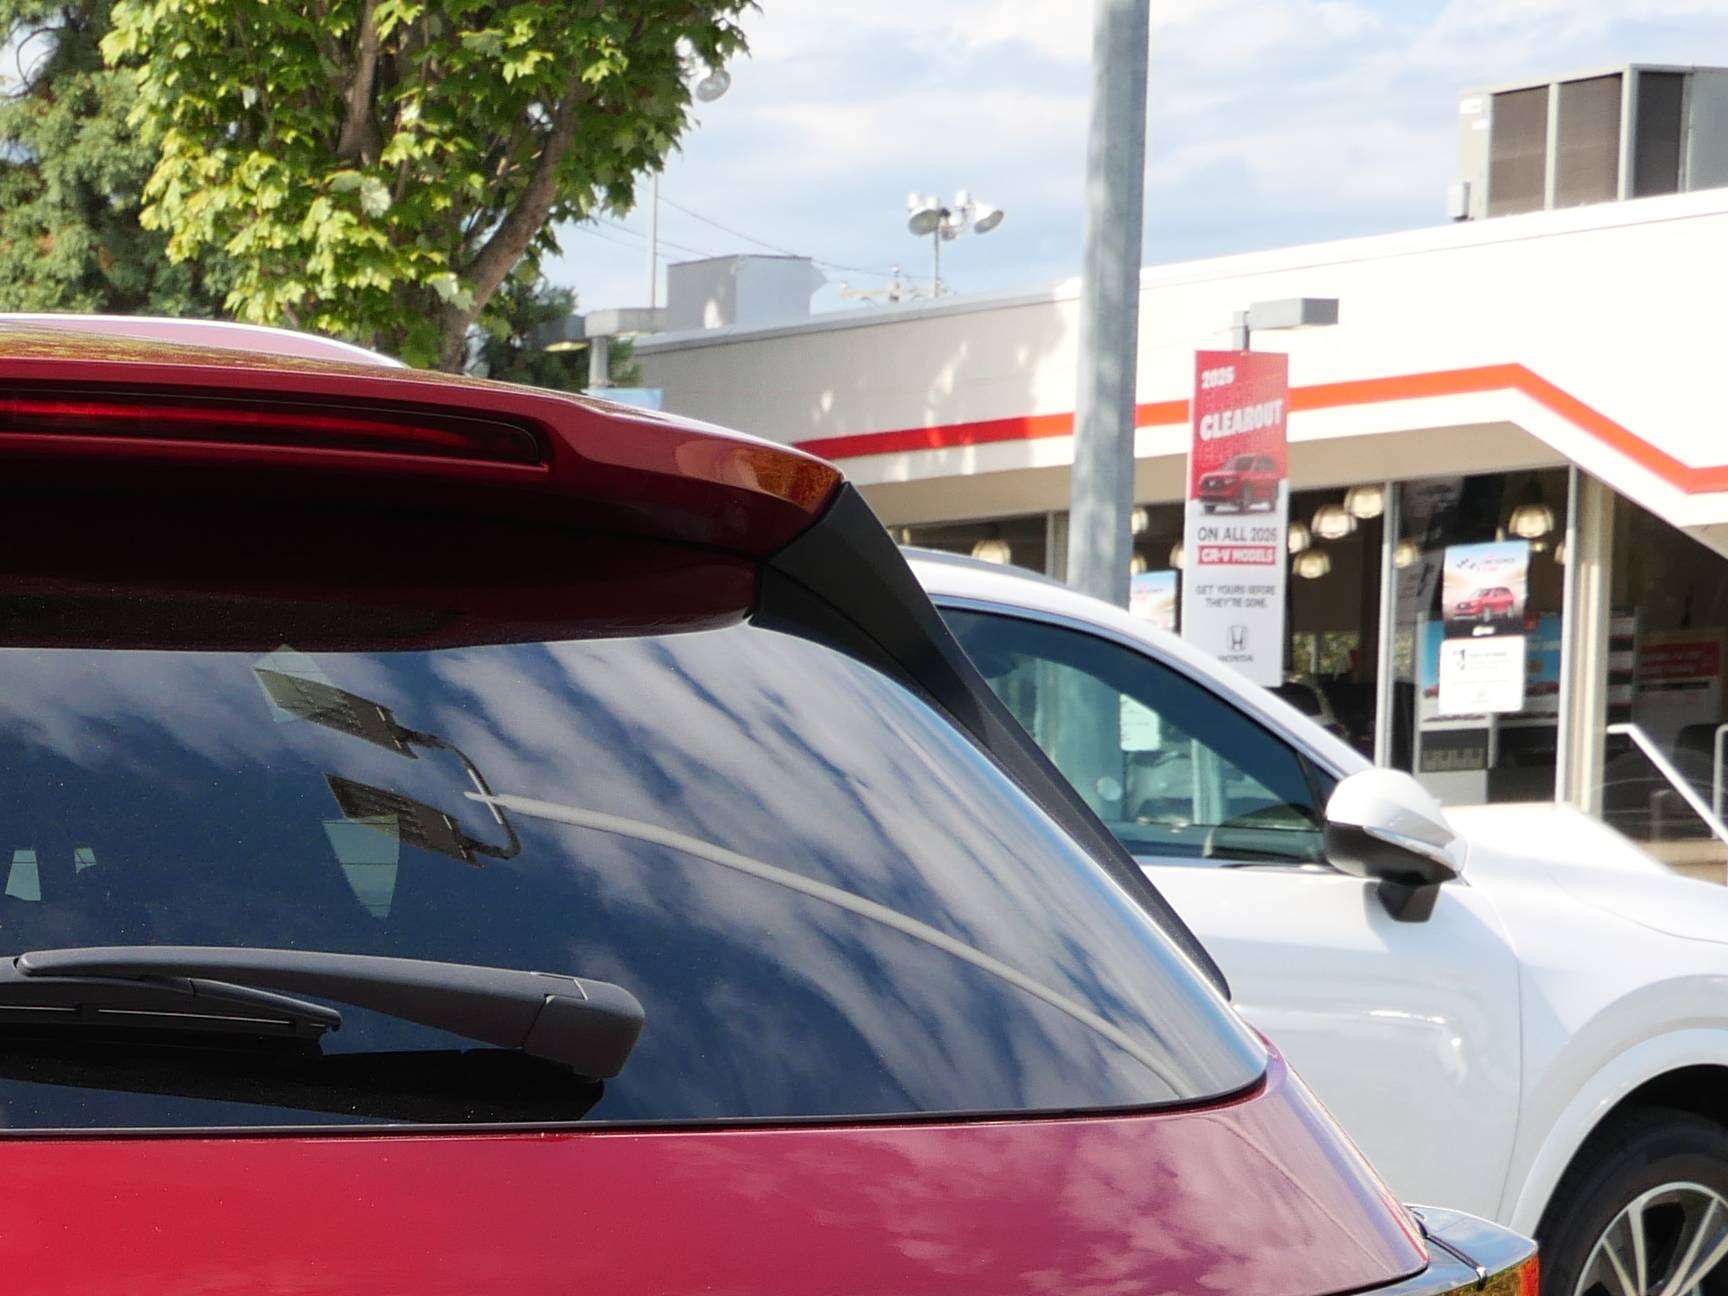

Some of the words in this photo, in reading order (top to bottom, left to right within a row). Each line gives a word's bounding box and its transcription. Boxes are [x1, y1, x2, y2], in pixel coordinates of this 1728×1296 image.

[1199, 398, 1283, 441] CLEAROUT
[1197, 526, 1219, 541] ON
[1222, 527, 1247, 541] ALL
[1200, 548, 1232, 562] CR-V
[1233, 547, 1274, 563] MODELS
